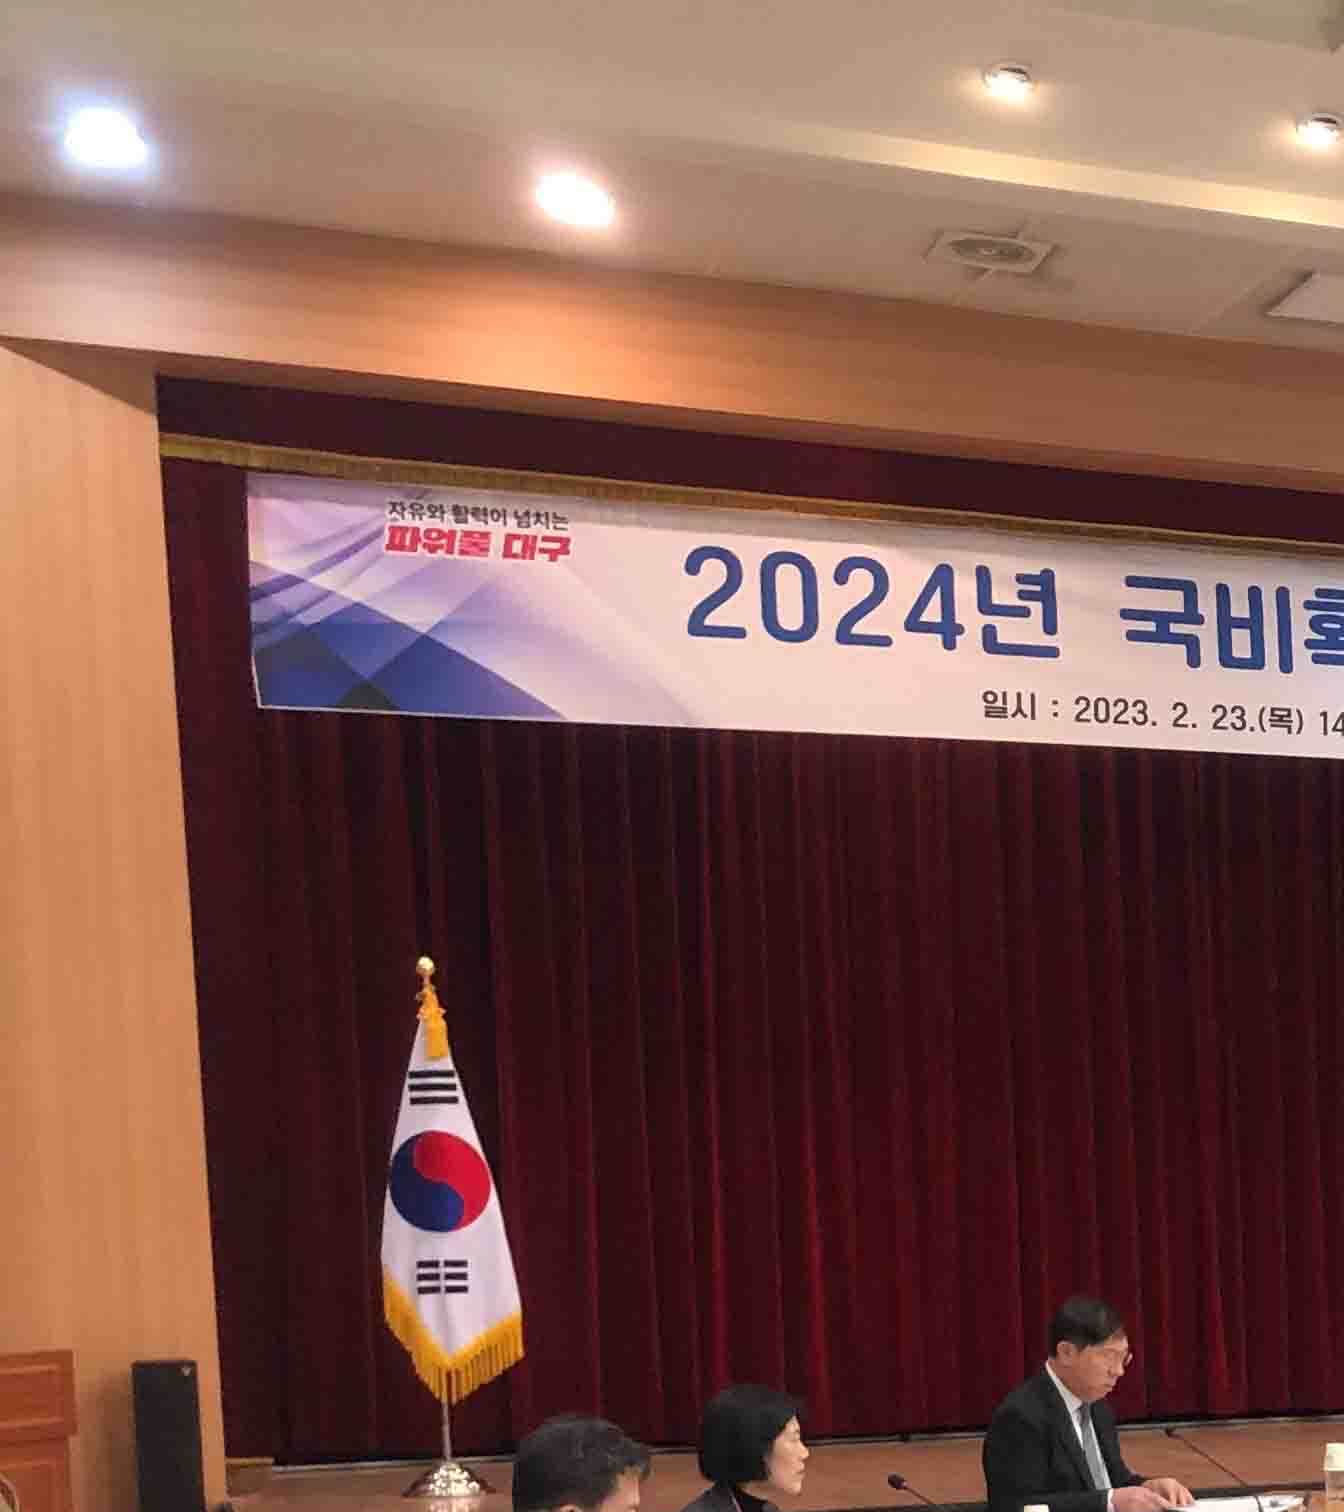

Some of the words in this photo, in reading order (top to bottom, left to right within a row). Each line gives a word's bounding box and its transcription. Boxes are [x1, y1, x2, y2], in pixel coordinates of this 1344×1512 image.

[387, 501, 446, 523] 자유와
[452, 504, 508, 528] 활력이
[513, 509, 569, 531] 넘치는
[384, 526, 491, 558] 파워풀
[502, 532, 572, 562] 대구
[685, 547, 1060, 660] 2024년
[981, 689, 1037, 721] 일시
[1073, 695, 1158, 727] 2023.
[1171, 701, 1198, 729] 2.
[1210, 704, 1305, 736] 23.(목)
